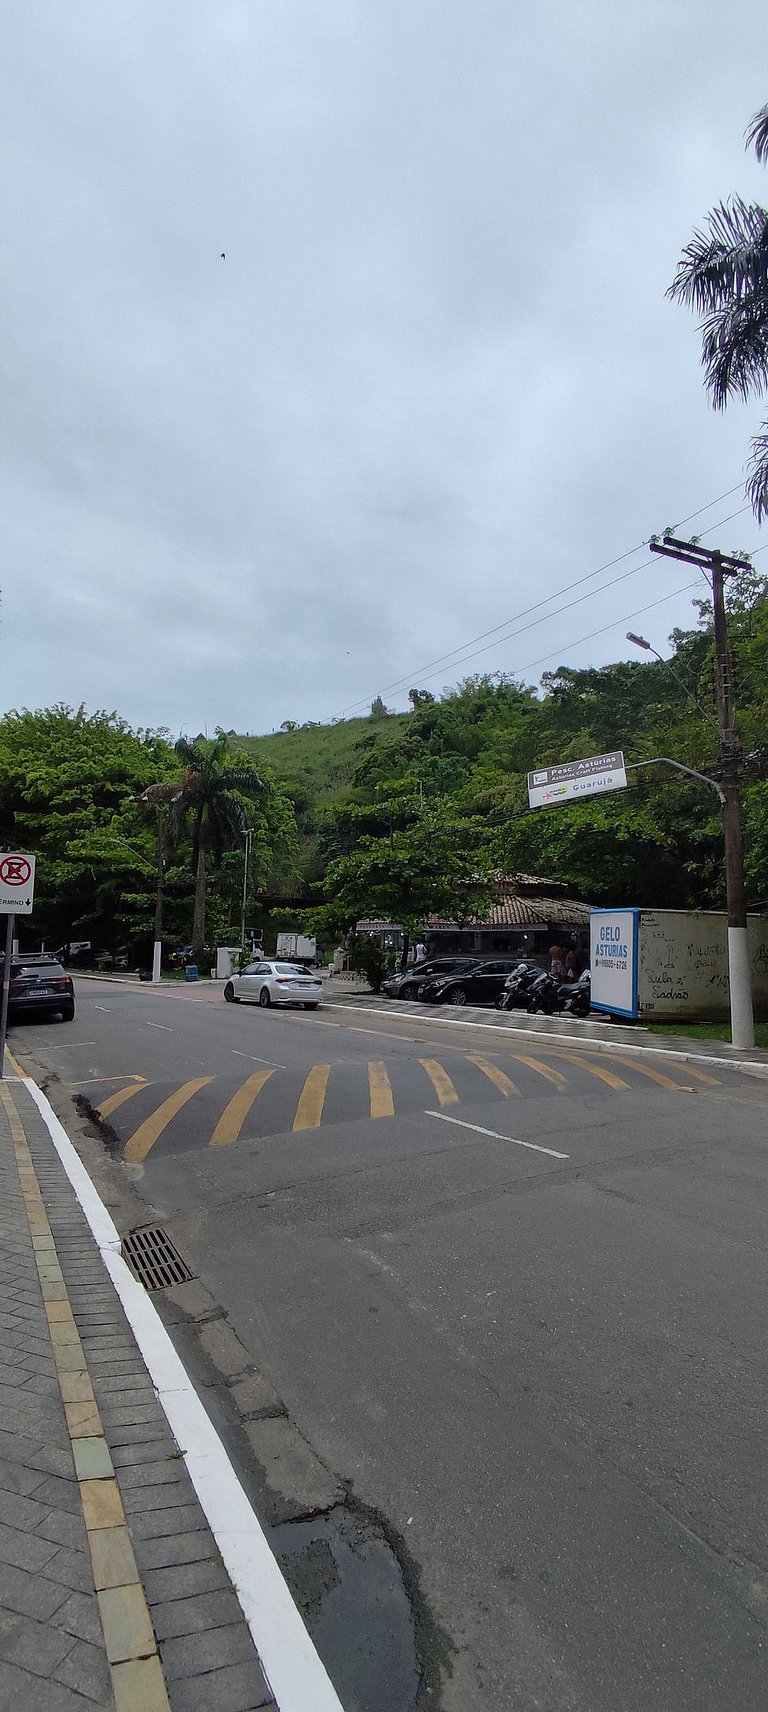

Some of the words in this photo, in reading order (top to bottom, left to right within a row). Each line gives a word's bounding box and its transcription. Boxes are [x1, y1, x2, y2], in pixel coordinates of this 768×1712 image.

[573, 778, 612, 791] Guarujá
[600, 926, 620, 941] GELO
[595, 944, 628, 958] ASTURIAS
